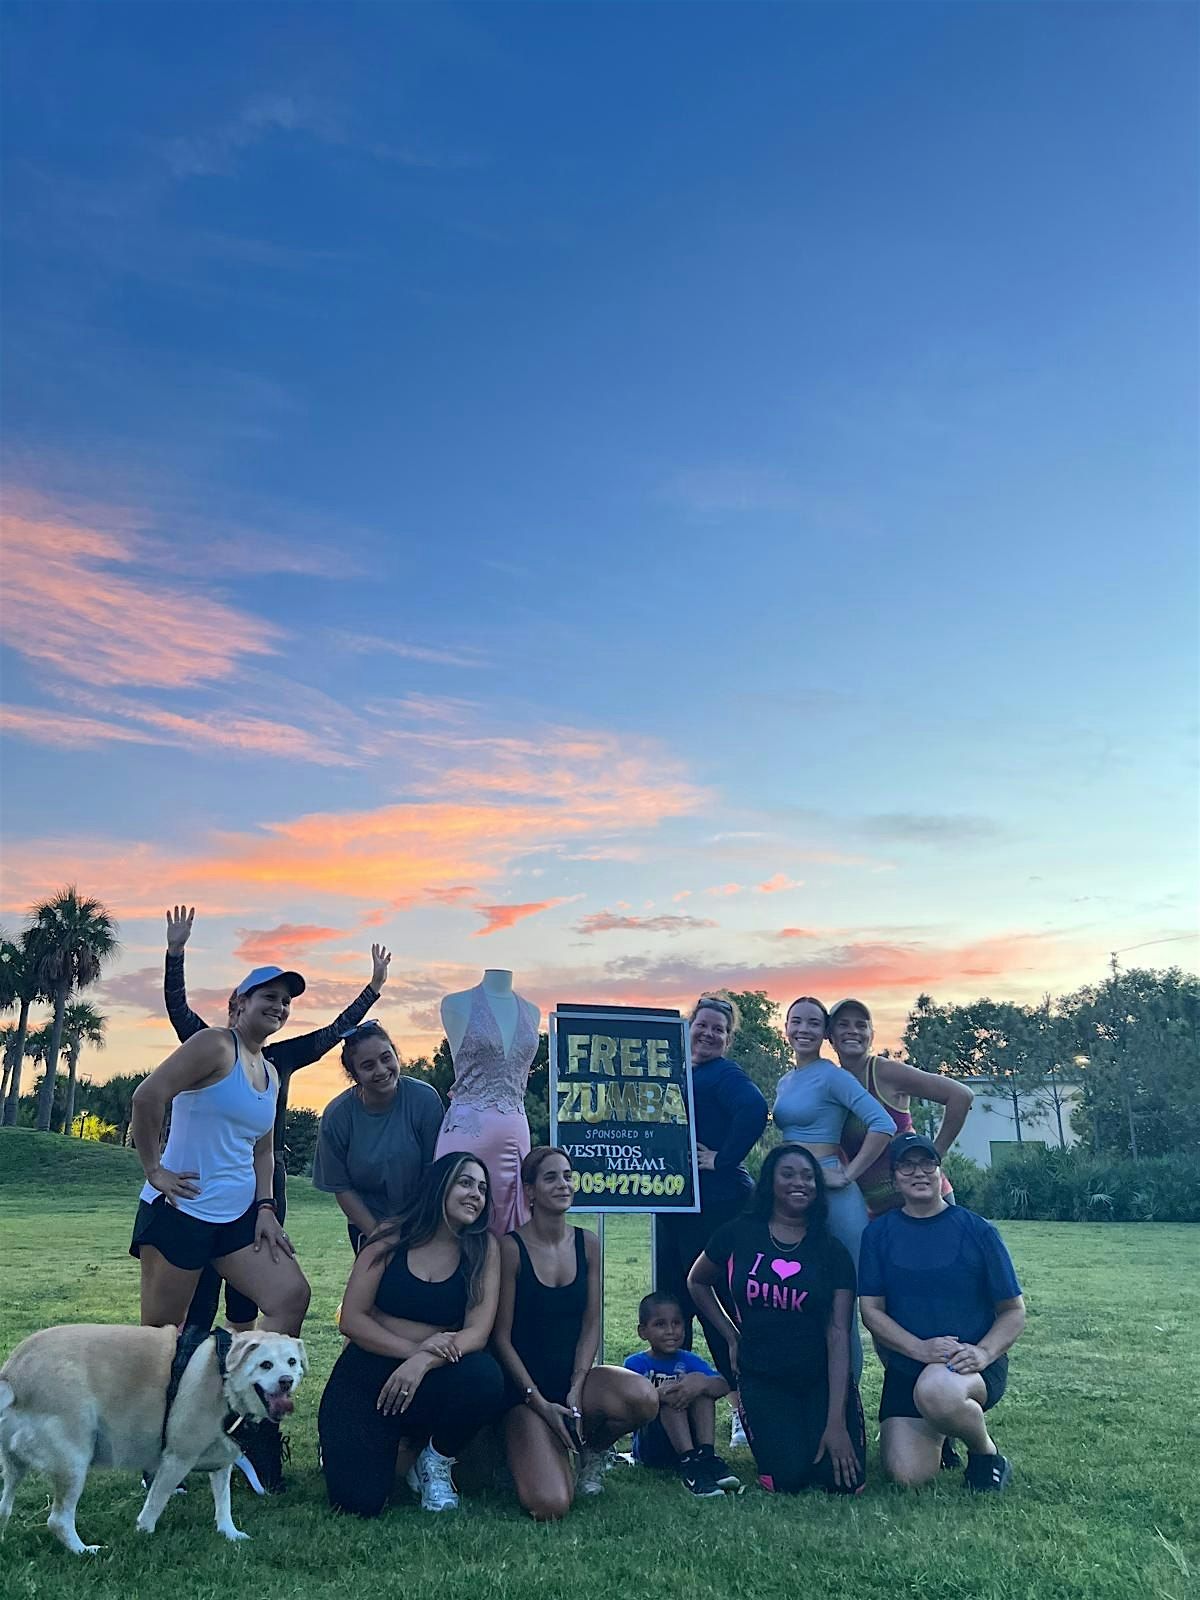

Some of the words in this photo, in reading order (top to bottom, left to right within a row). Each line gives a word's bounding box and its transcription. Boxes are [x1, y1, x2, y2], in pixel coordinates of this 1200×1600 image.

[567, 1034, 672, 1078] FREE
[557, 1081, 689, 1125] ZUMBA
[585, 1129, 639, 1139] SPONSORED
[645, 1130, 654, 1139] BY
[562, 1144, 642, 1158] VESTIDOS
[607, 1157, 666, 1171] MIAMI
[748, 1252, 765, 1276] I
